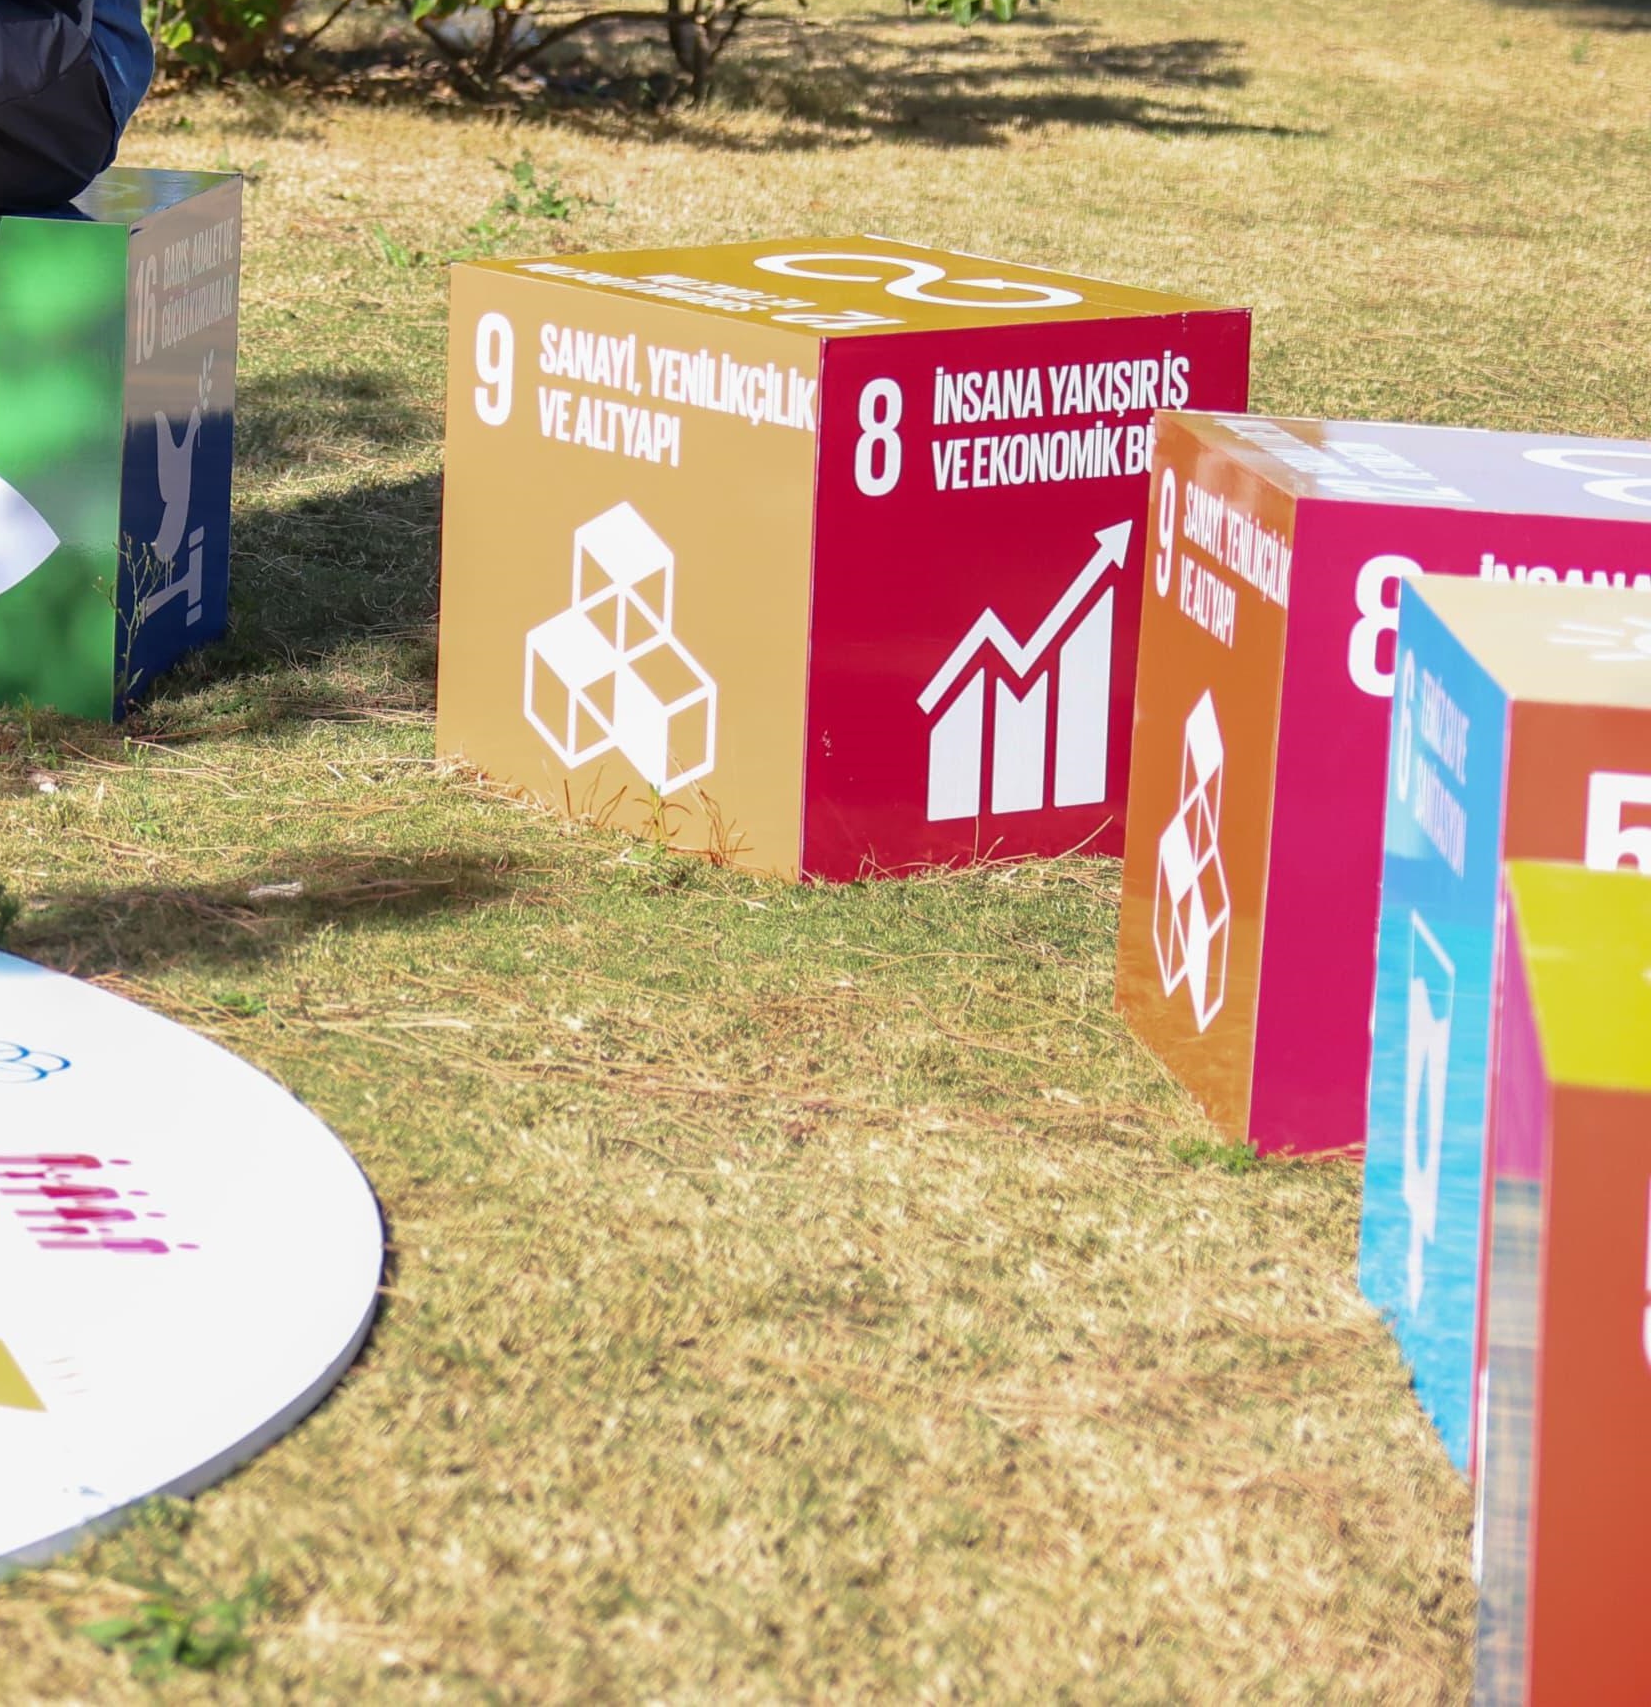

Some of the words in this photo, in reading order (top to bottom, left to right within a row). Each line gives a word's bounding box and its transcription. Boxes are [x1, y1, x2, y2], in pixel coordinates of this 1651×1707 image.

[191, 223, 223, 277] ADALET
[223, 218, 234, 262] VE
[135, 254, 157, 365] 16
[161, 288, 186, 349] GÜÇLÜ
[187, 274, 233, 338] KURUMLAR
[475, 312, 514, 426] 9
[539, 322, 642, 397] SANAYİ,
[647, 346, 817, 432] YENİLİKÇİLİK
[933, 366, 1044, 425] İNSANA
[1048, 359, 1159, 418] YAKIŞIR
[1161, 350, 1190, 411] İŞ
[538, 387, 571, 443] VE
[573, 394, 681, 467] ALTYAPI
[854, 377, 903, 497] 8
[931, 439, 971, 491] VE
[972, 420, 1123, 488] EKONOMİK
[1156, 468, 1176, 597] 9
[1183, 481, 1224, 566] SANAYİ,
[1225, 509, 1293, 610] YENİLİKÇİLİK
[1180, 553, 1194, 616] VE
[1193, 565, 1236, 649] ALTYAPI
[1347, 554, 1424, 697] 8
[1397, 648, 1415, 802] 6
